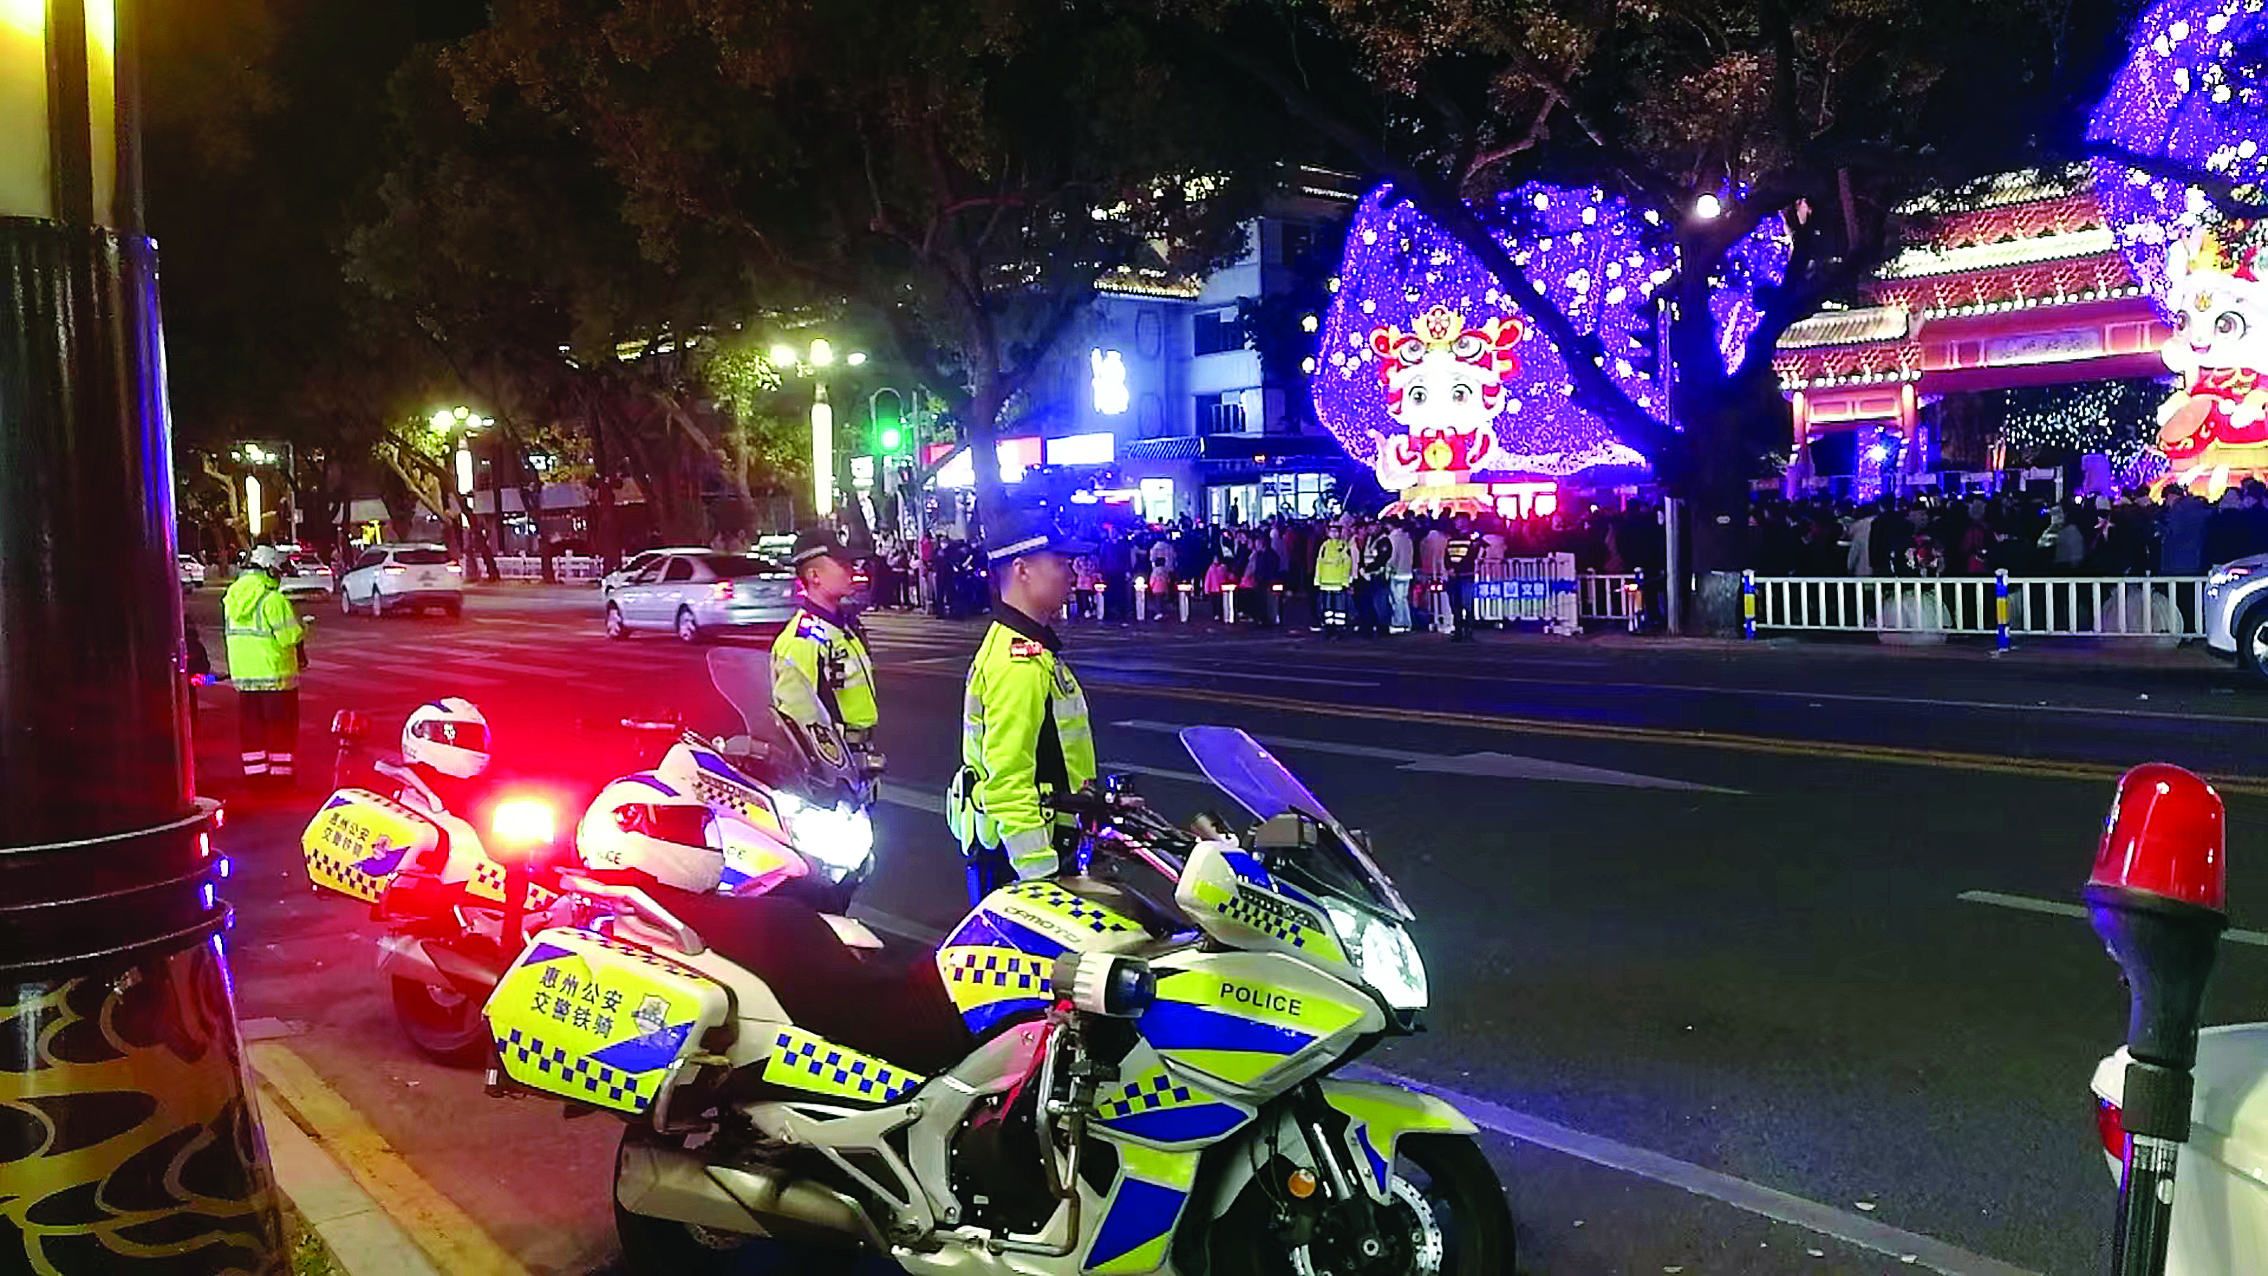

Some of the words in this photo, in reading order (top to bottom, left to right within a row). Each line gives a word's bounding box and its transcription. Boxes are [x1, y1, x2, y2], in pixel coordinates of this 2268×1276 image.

[539, 966, 623, 1013] 惠州公安
[1220, 983, 1302, 1016] POLICE
[531, 991, 615, 1039] 交警铁骑
